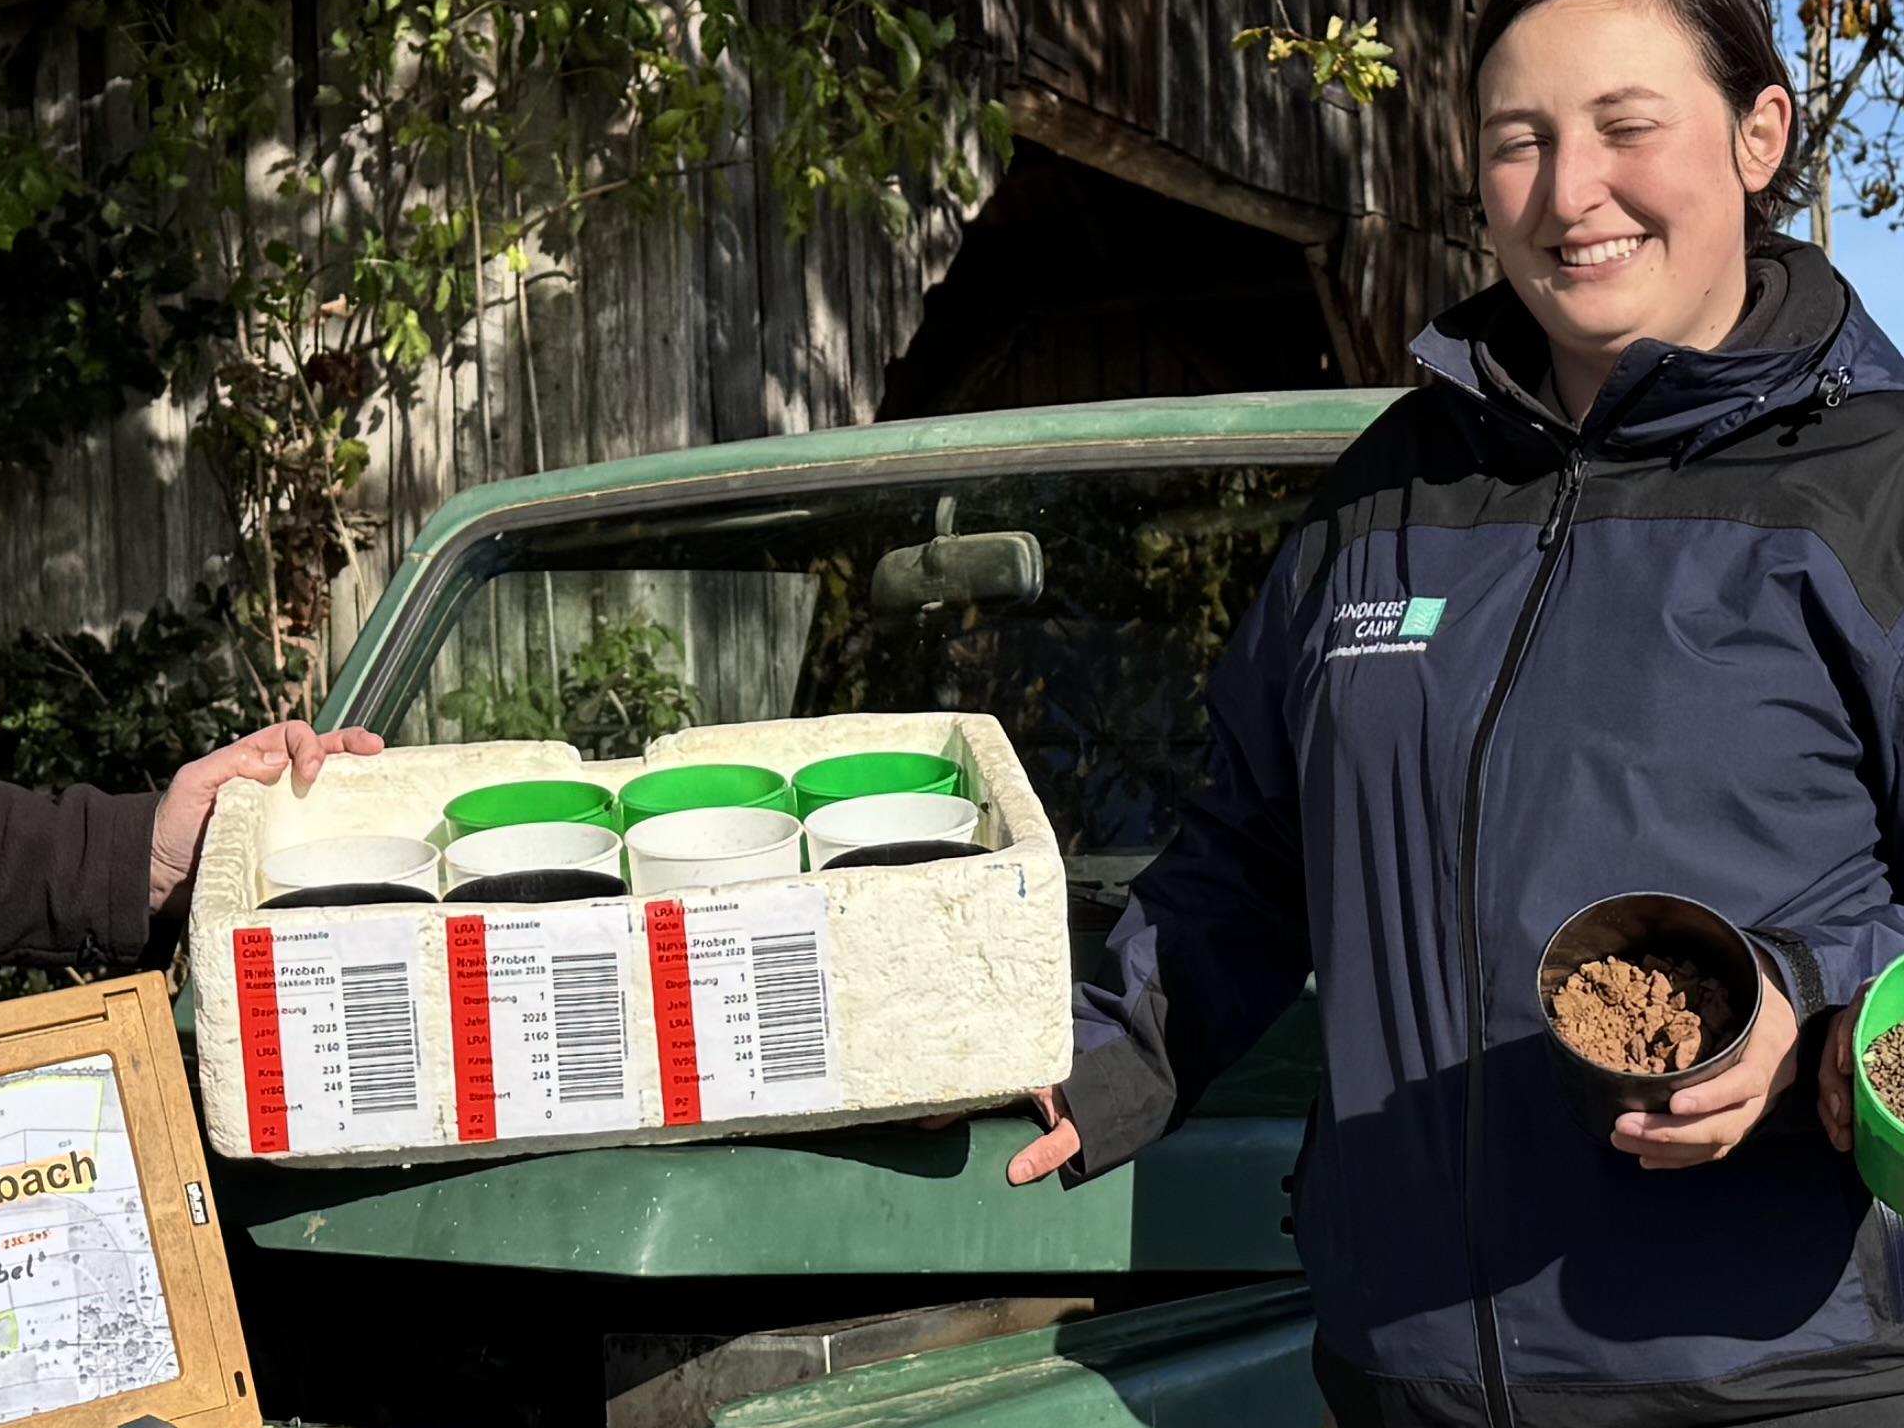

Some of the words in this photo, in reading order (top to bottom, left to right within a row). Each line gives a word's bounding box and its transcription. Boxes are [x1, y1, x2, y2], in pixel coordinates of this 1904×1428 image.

[1355, 620, 1398, 638] CALW
[740, 973, 745, 982] 1
[540, 992, 545, 1000] 1
[724, 993, 749, 1005] 2025
[329, 1002, 334, 1011] 1
[522, 1012, 547, 1023] 2025
[726, 1012, 750, 1024] 2160
[312, 1023, 338, 1034] 2025
[524, 1031, 549, 1042] 2160
[734, 1035, 752, 1045] 235
[314, 1042, 340, 1053] 2160
[531, 1054, 550, 1064] 235
[735, 1052, 754, 1061] 245
[322, 1065, 342, 1075] 235
[533, 1071, 551, 1081] 245
[324, 1082, 343, 1092] 245
